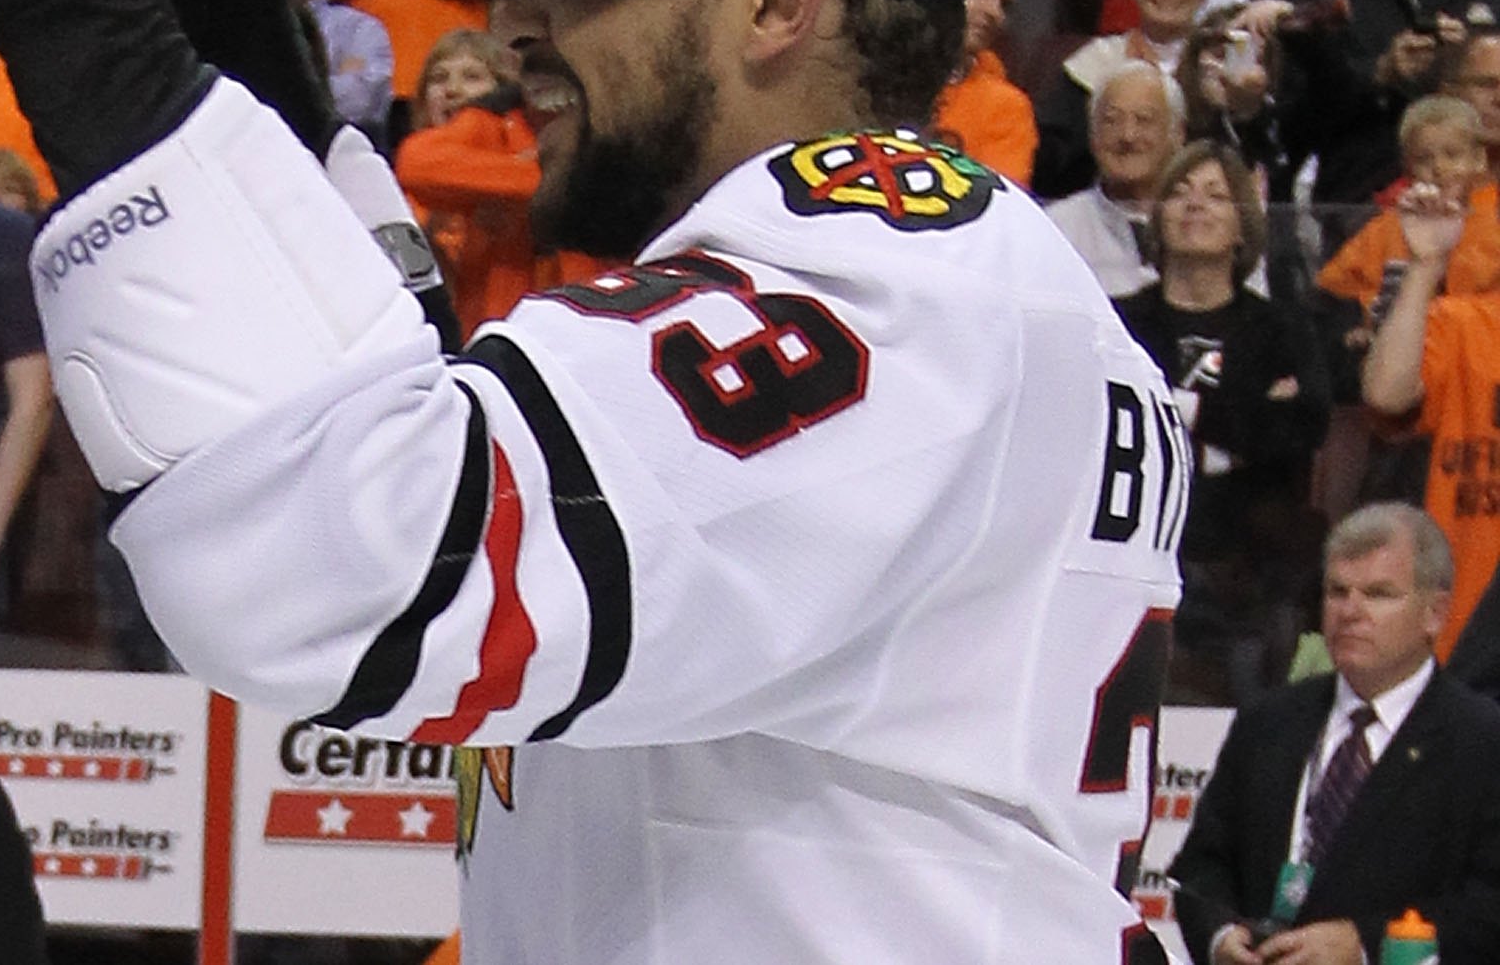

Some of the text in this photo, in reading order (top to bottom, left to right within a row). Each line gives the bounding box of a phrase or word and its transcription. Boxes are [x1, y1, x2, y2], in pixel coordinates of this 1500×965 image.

[37, 185, 172, 293] Reebok
[53, 721, 173, 752] Painters
[280, 719, 458, 779] Certa
[51, 817, 172, 850] Painters
